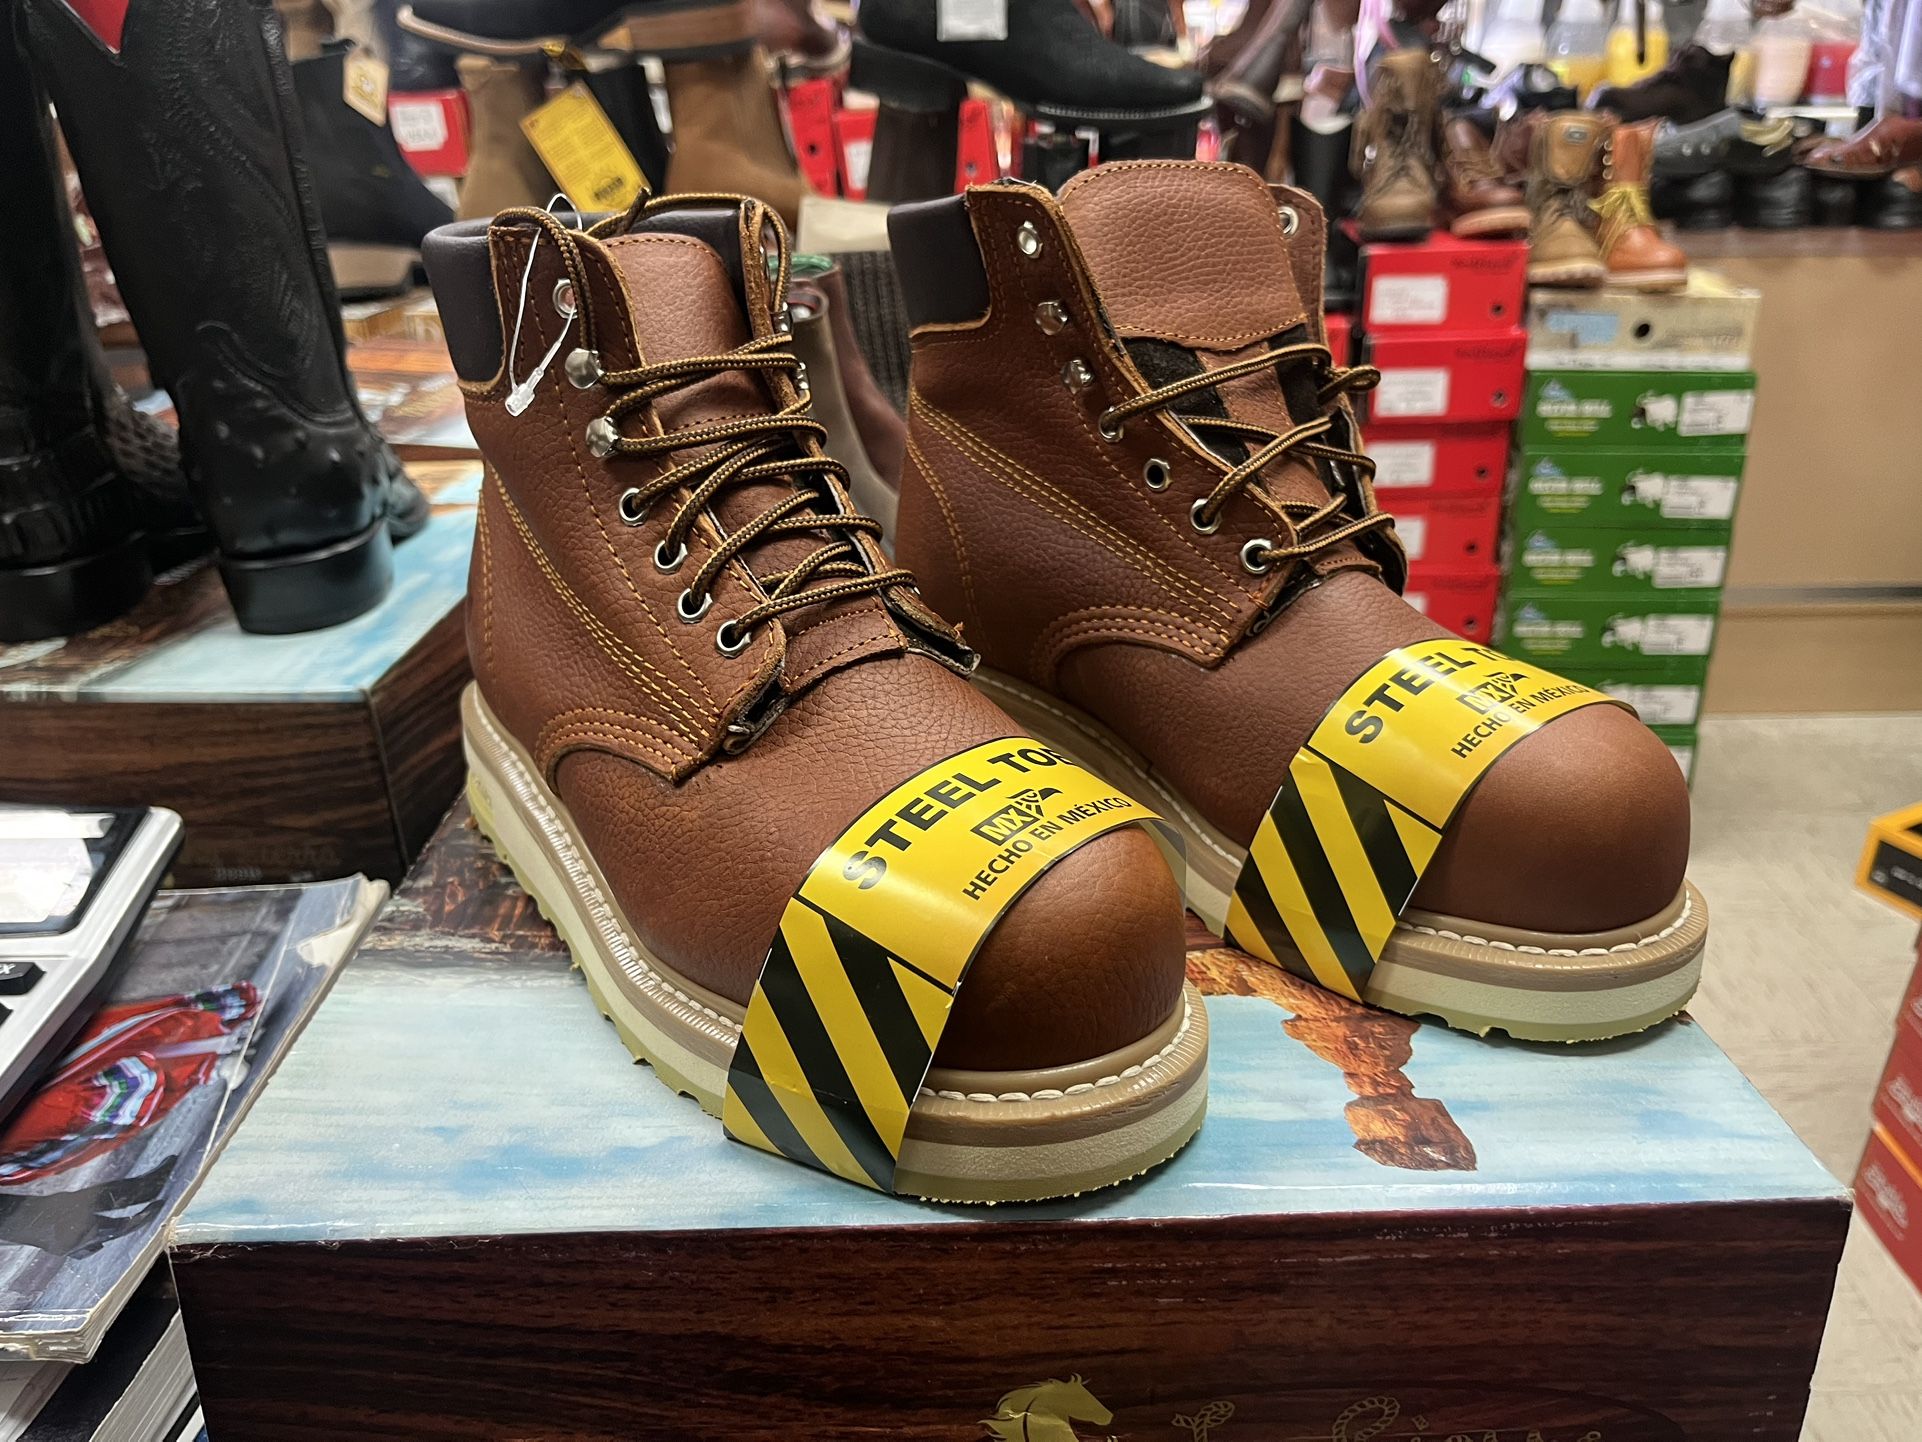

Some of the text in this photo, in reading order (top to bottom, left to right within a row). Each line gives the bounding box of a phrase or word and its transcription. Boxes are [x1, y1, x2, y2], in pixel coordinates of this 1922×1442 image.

[1345, 651, 1476, 744] STEEL
[1450, 710, 1511, 758] HECHO
[1508, 697, 1537, 713] EN
[842, 772, 1002, 890] STEEL
[962, 796, 1132, 900] HECHO EN MÉXICO
